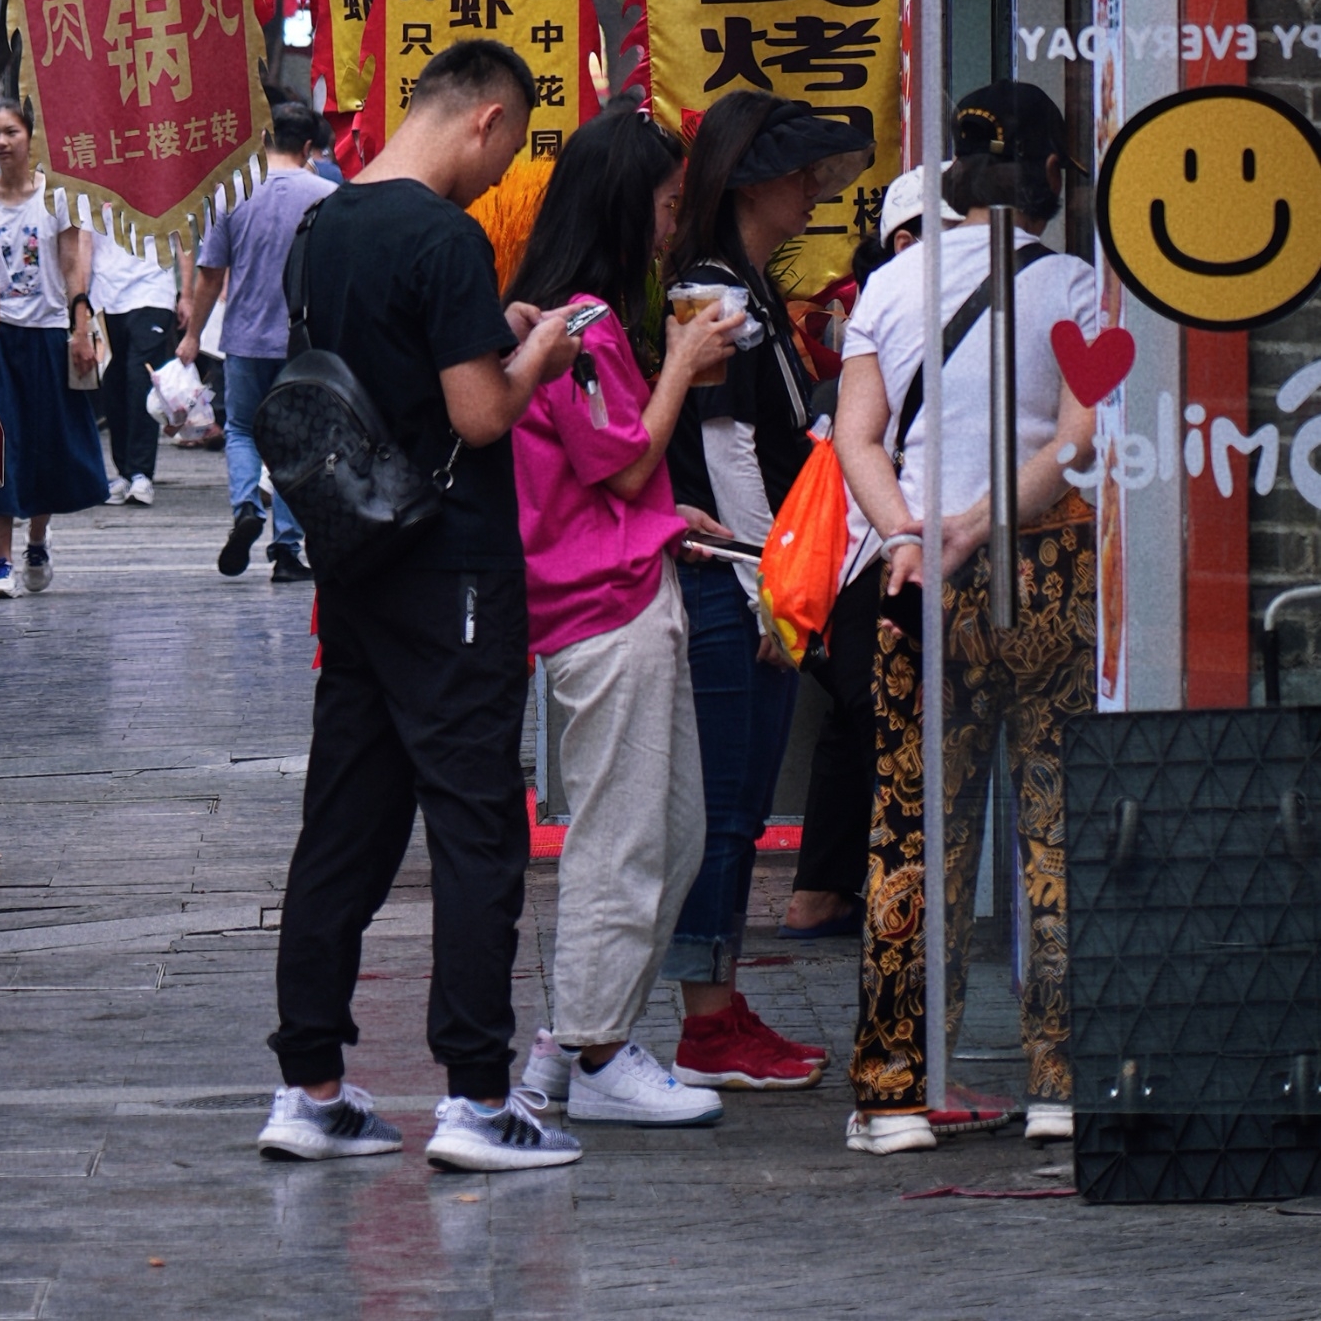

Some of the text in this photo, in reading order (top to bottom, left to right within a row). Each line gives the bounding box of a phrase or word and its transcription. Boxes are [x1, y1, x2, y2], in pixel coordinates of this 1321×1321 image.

[62, 109, 240, 170] 请上二楼左转
